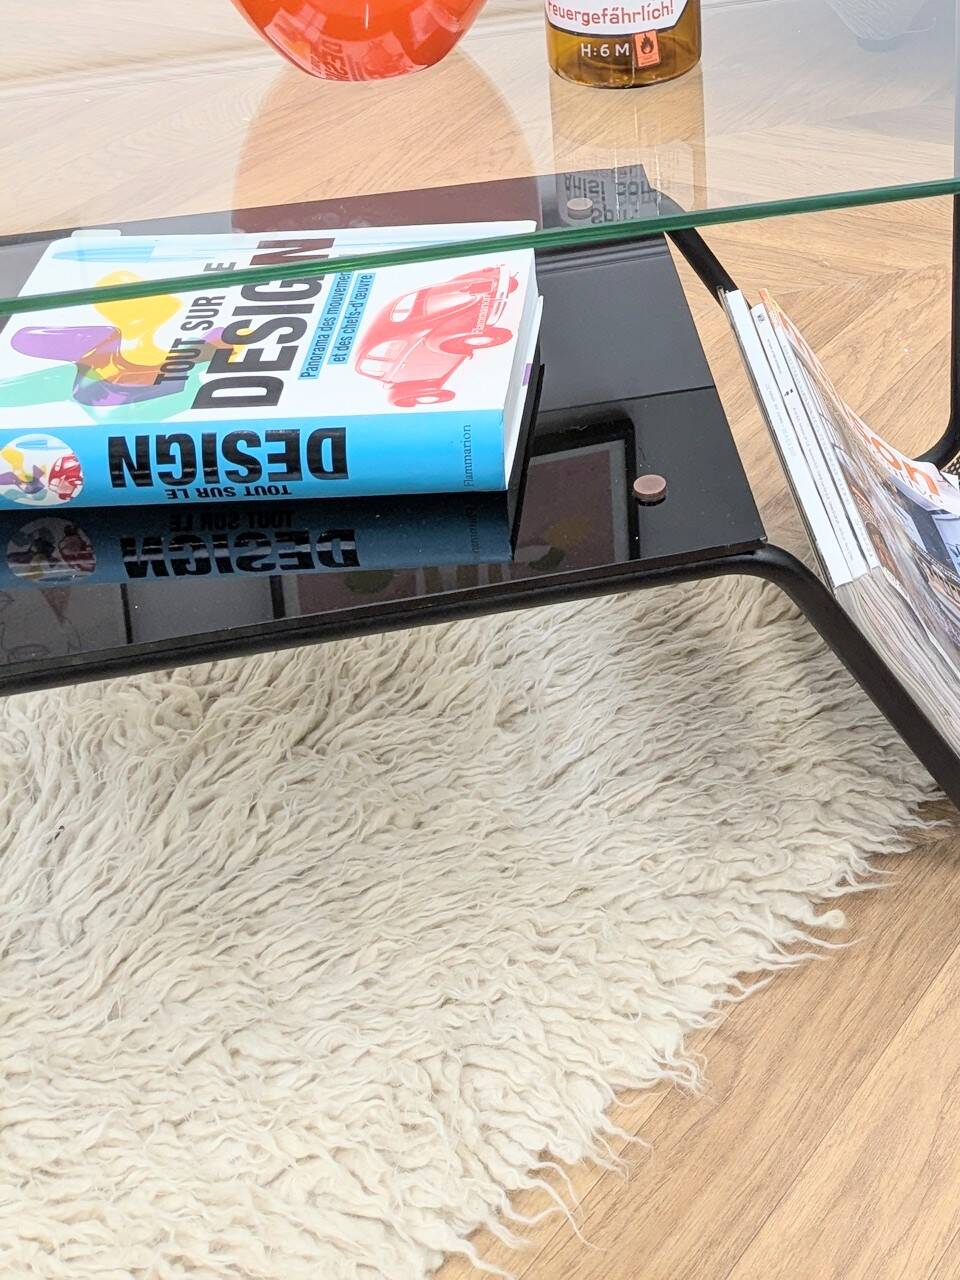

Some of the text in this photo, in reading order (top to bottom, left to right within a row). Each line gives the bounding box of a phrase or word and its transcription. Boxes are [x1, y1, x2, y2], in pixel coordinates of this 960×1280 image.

[615, 43, 630, 57] M
[153, 338, 206, 385] TOUT
[180, 295, 226, 331] SUR
[190, 237, 336, 410] DESIGN
[300, 334, 330, 378] Panorama
[320, 317, 337, 331] des
[334, 335, 353, 353] des
[332, 353, 346, 362] et
[107, 426, 350, 489] DESIGN
[463, 424, 475, 487] Flammarion
[165, 484, 292, 500] TOUT SUR LE
